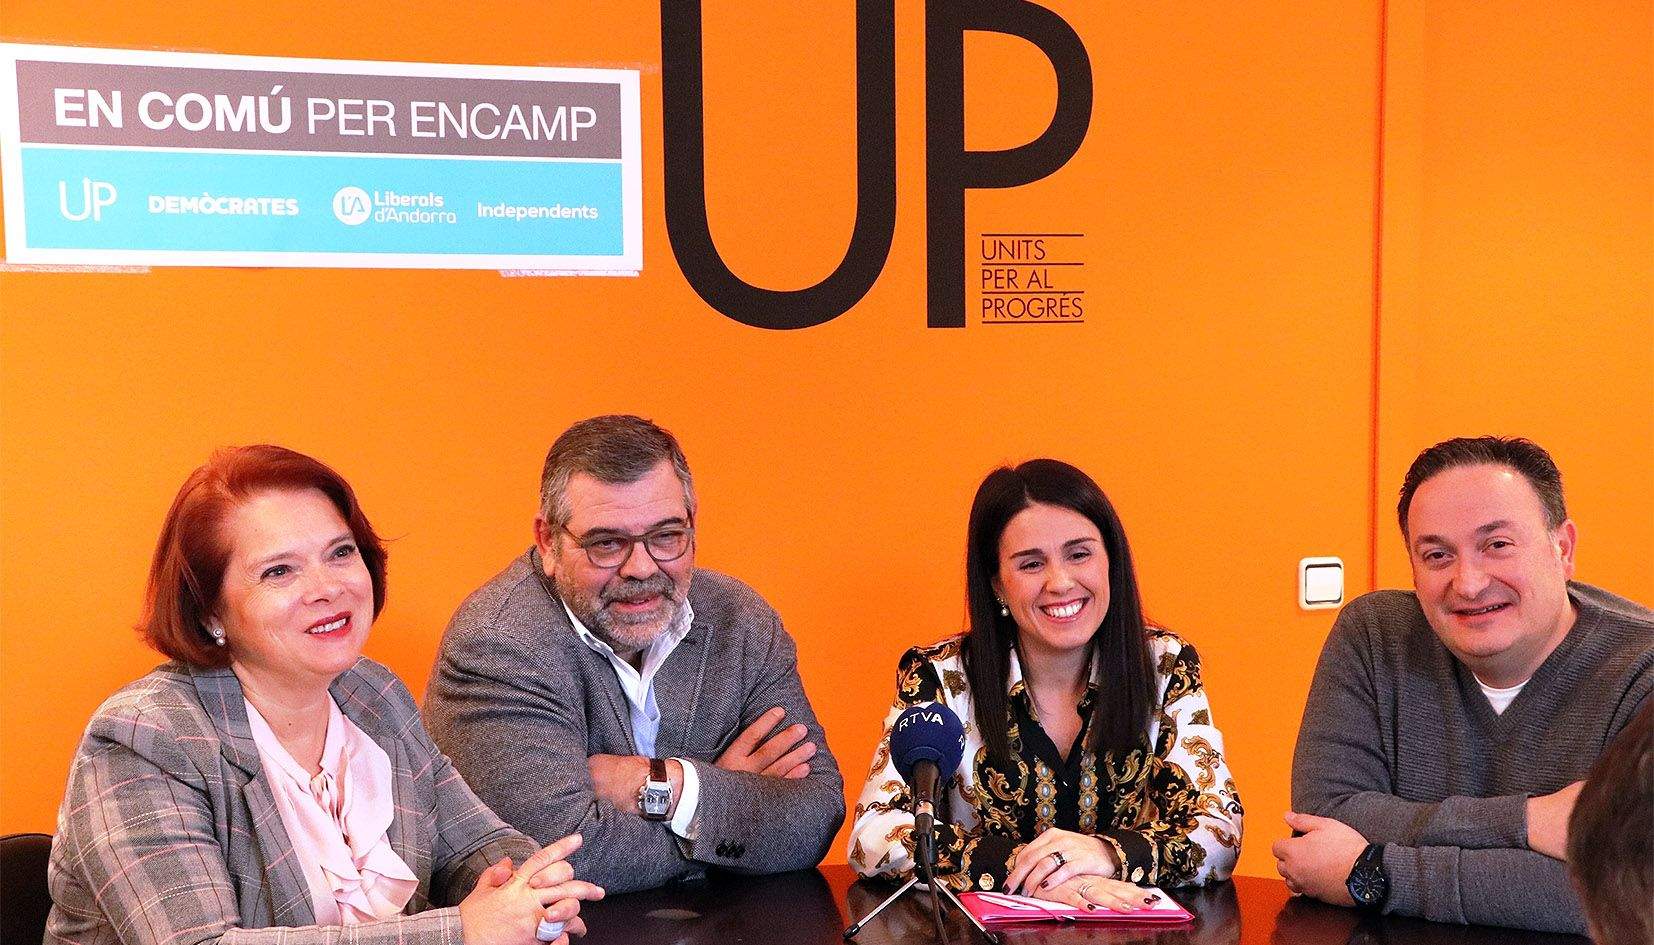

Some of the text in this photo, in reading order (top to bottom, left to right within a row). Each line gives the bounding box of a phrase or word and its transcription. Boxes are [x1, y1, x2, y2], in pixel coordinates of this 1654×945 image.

[54, 85, 597, 141] EN COMÚ PER ENCAMP
[659, 0, 1093, 330] UP
[59, 177, 118, 222] UP
[148, 192, 299, 216] DEMÒCRATES
[374, 190, 444, 207] Liberals
[374, 207, 457, 224] d'Andorra
[477, 202, 599, 221] Independents
[982, 239, 1045, 260] UNITS
[982, 269, 1053, 289] PER AL
[982, 293, 1083, 318] PROGRÉS
[899, 711, 944, 732] RTVA
